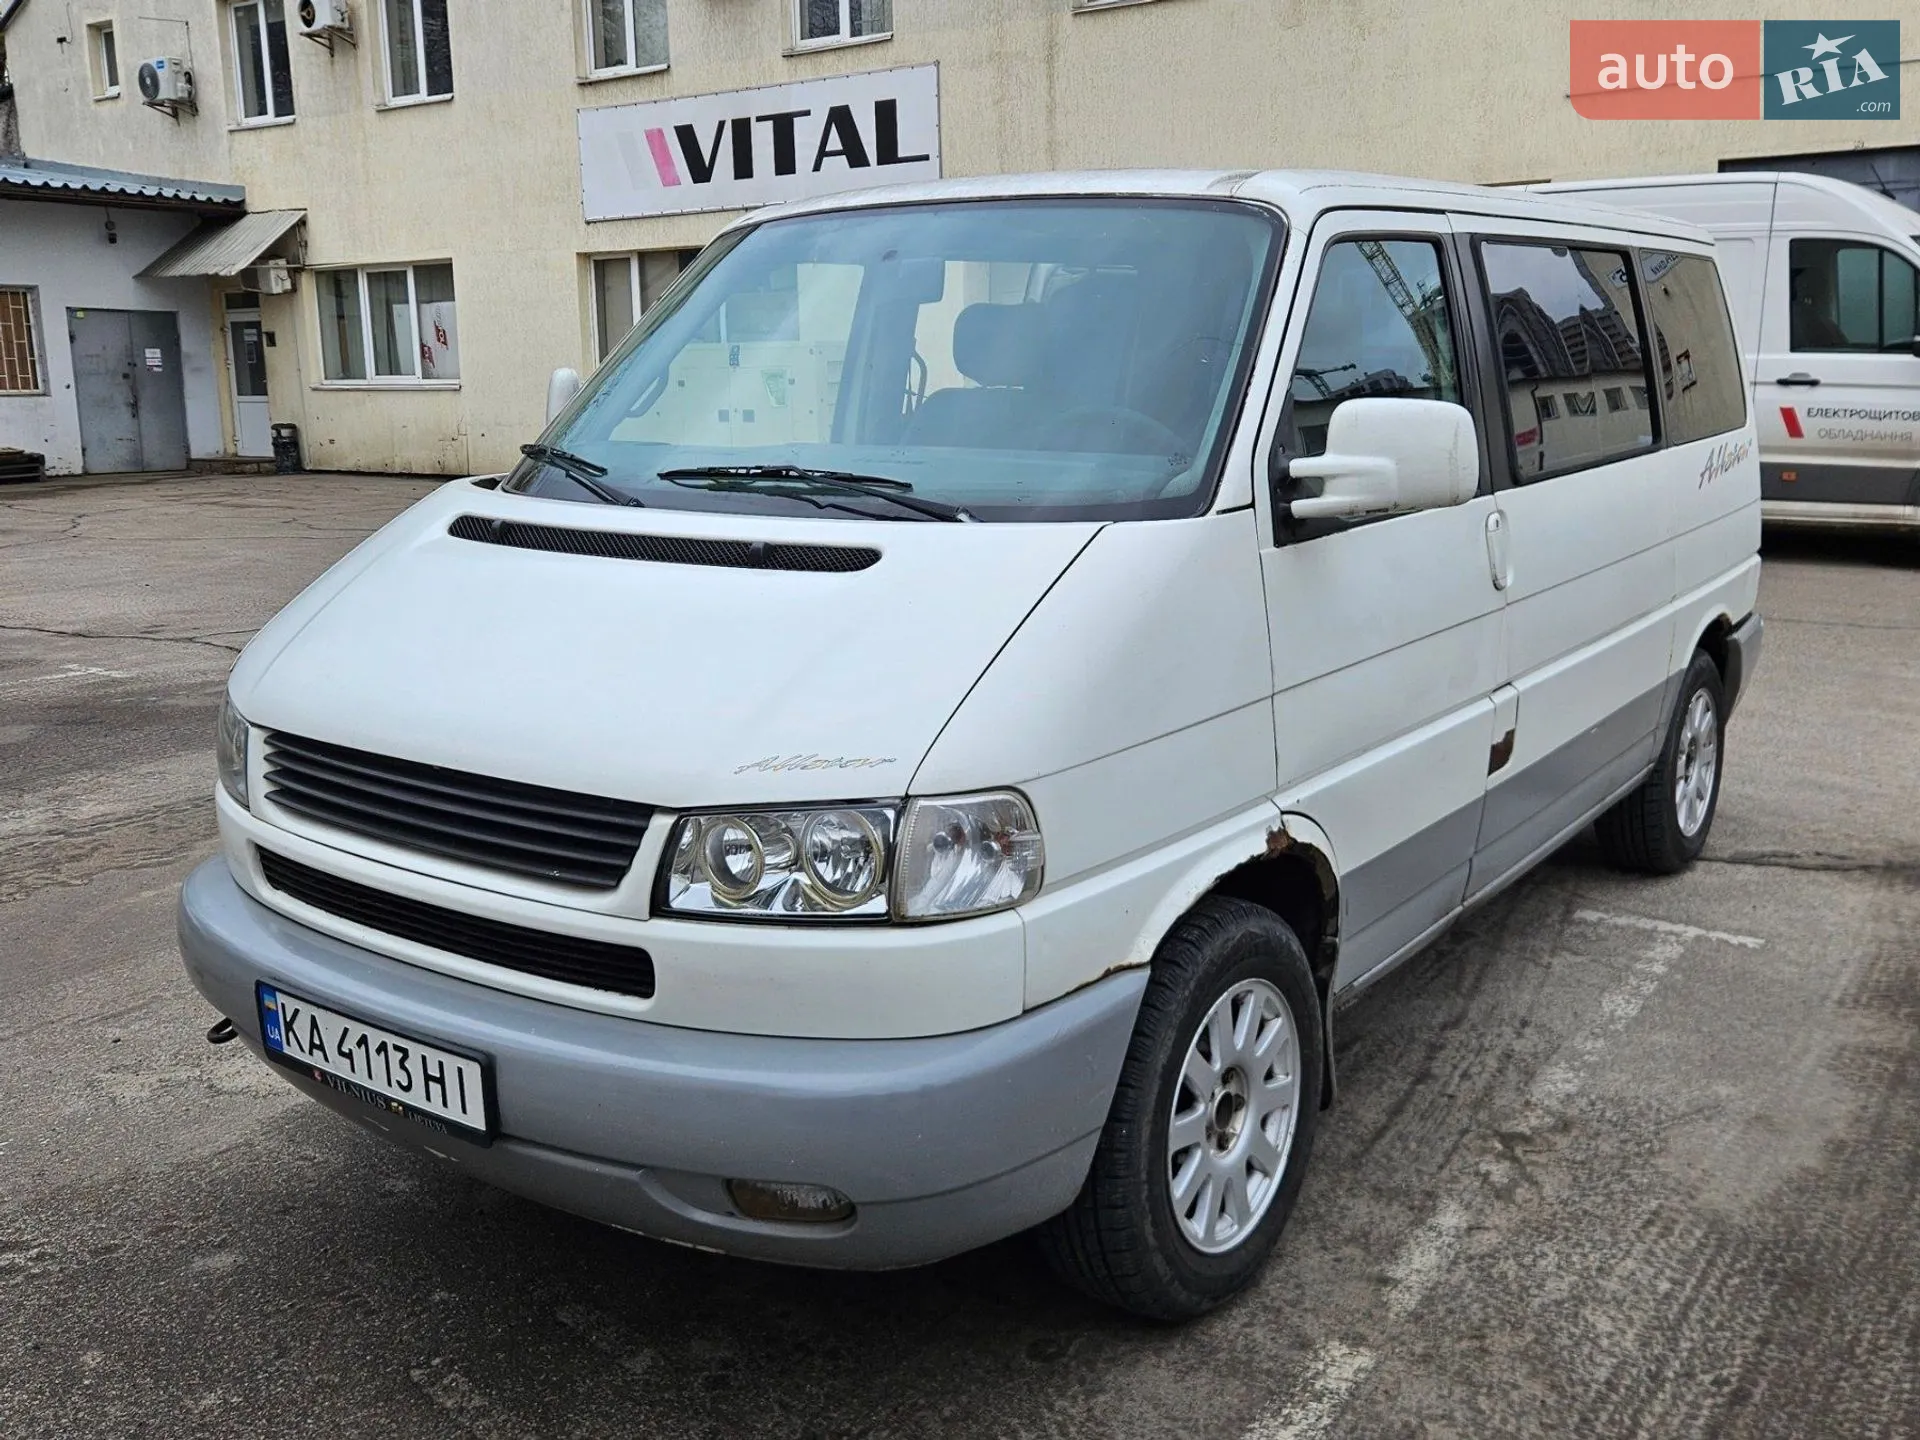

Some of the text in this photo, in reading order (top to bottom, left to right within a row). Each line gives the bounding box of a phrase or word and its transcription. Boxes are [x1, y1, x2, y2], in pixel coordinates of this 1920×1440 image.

[674, 98, 930, 185] VITAL
[1818, 427, 1913, 441] ОБЛАДНАННЯ
[267, 1023, 282, 1042] UA
[280, 1002, 468, 1115] KA 4113 HI
